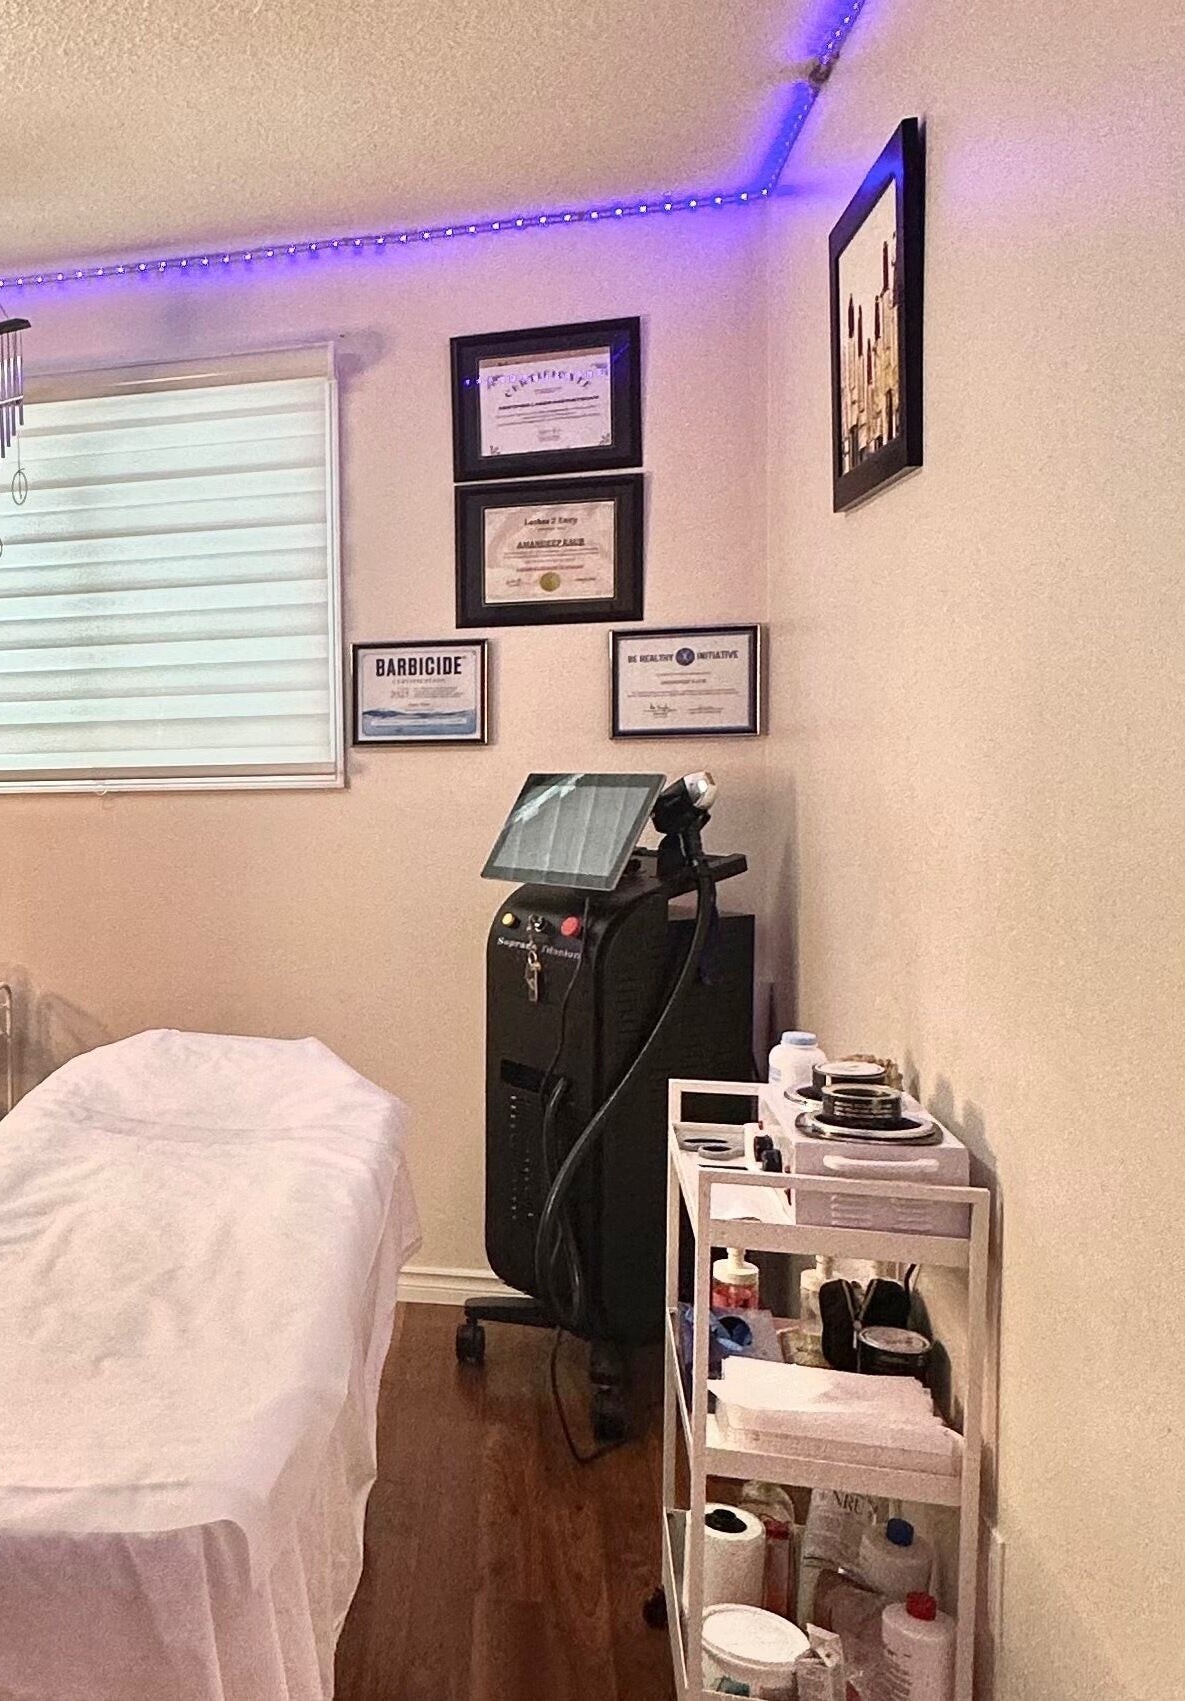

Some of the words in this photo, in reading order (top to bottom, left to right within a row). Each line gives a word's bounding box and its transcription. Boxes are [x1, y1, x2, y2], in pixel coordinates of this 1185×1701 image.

[639, 653, 674, 663] HEALTHY
[696, 650, 739, 660] INITIATIVE
[375, 656, 463, 677] BARBICIDE
